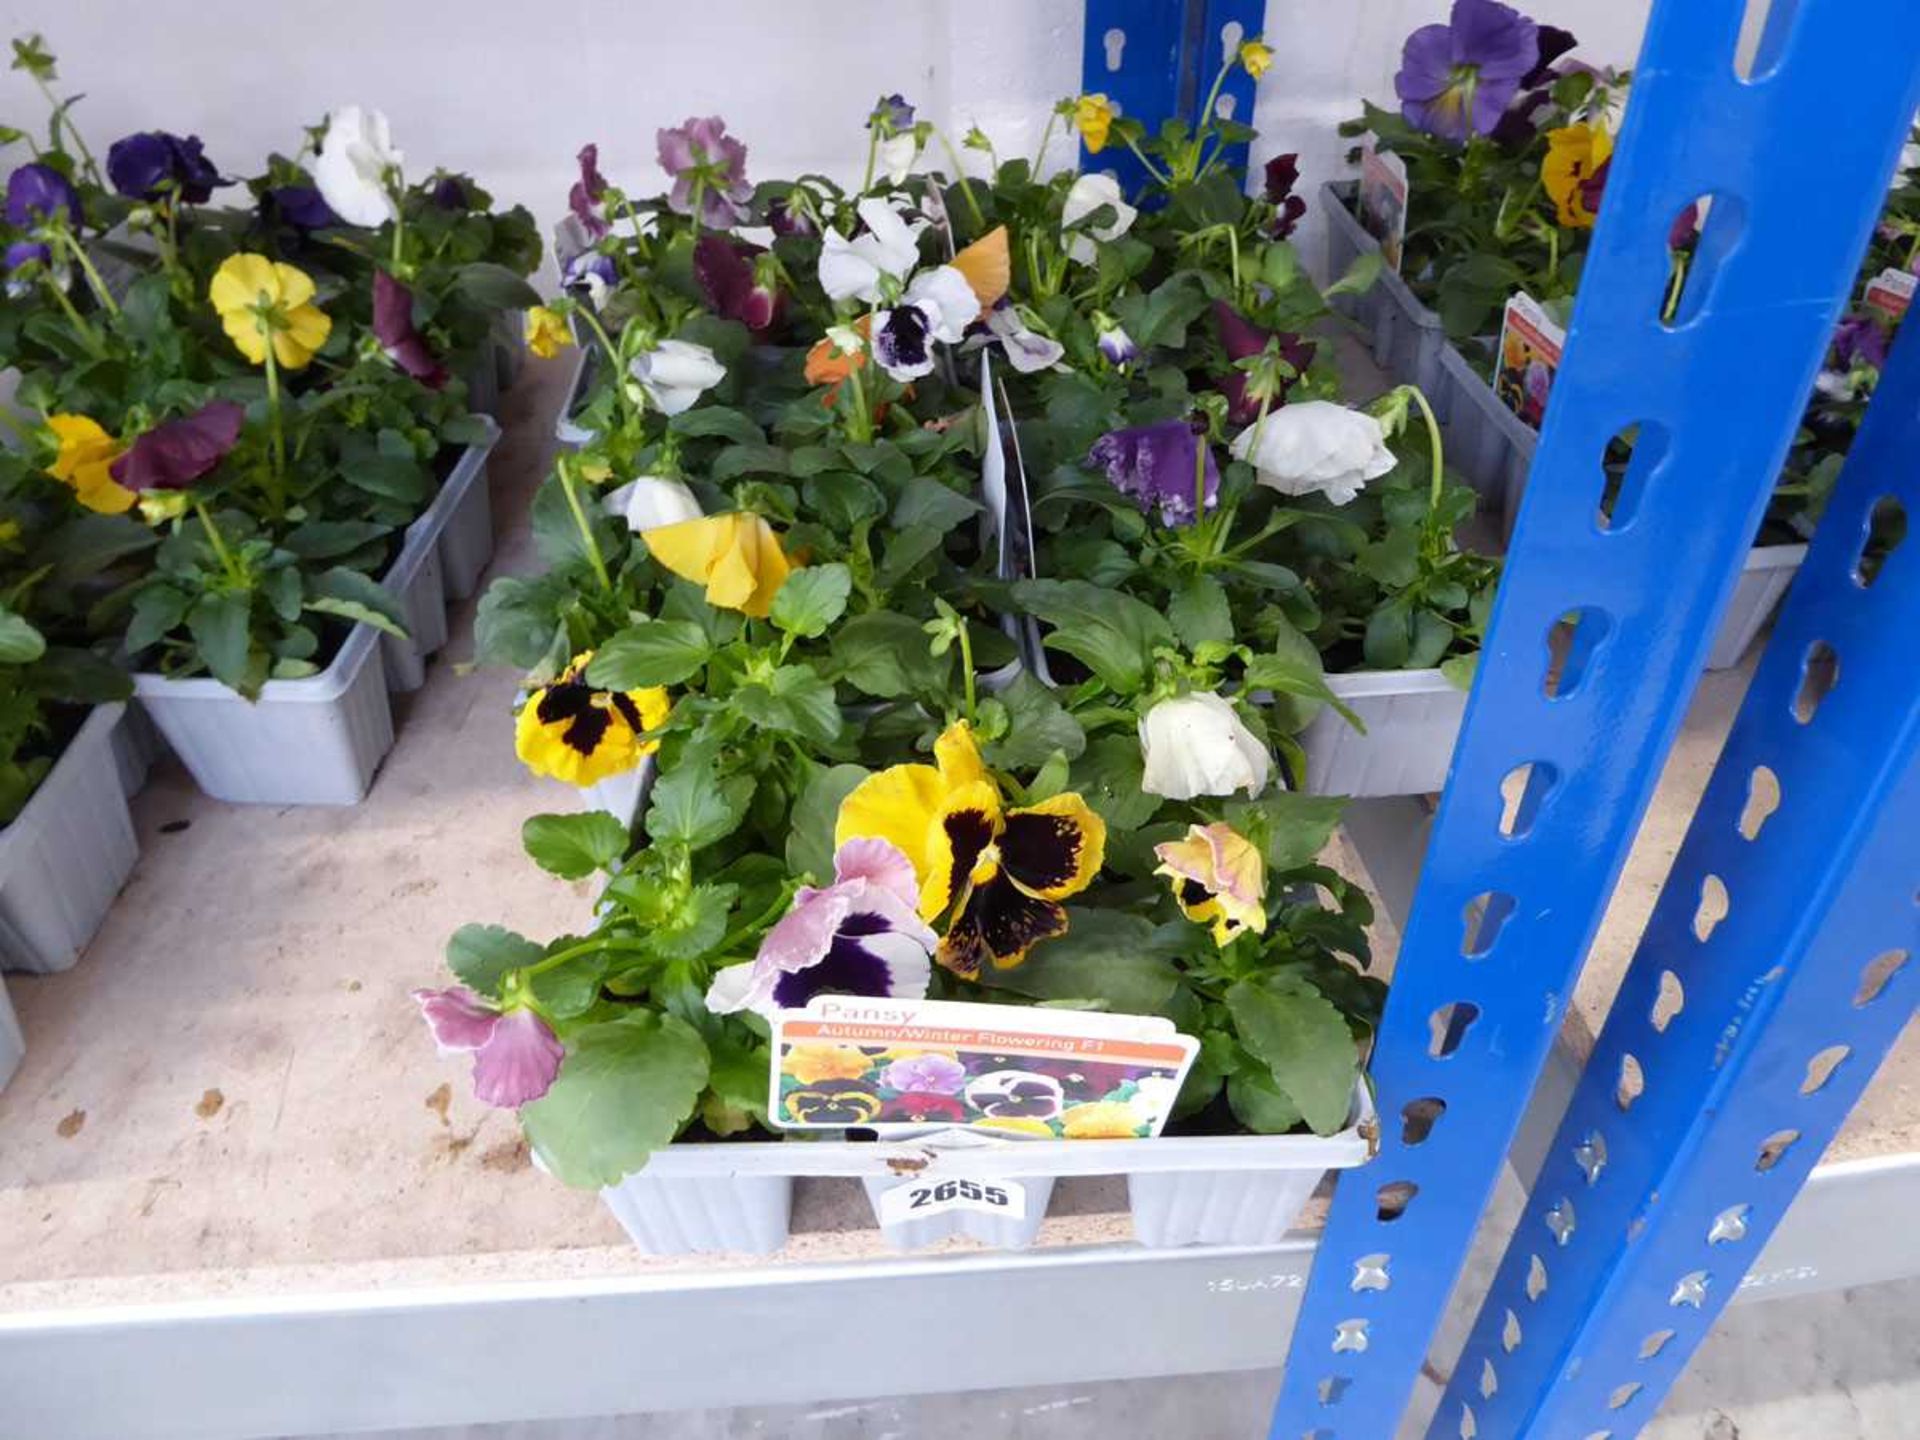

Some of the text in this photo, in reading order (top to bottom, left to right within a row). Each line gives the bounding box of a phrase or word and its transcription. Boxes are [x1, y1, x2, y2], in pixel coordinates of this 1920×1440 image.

[821, 1002, 917, 1024] Pansy
[817, 1024, 973, 1042] Autumn/Winter
[977, 1031, 1076, 1052] Flowering
[909, 1179, 1009, 1209] 2655
